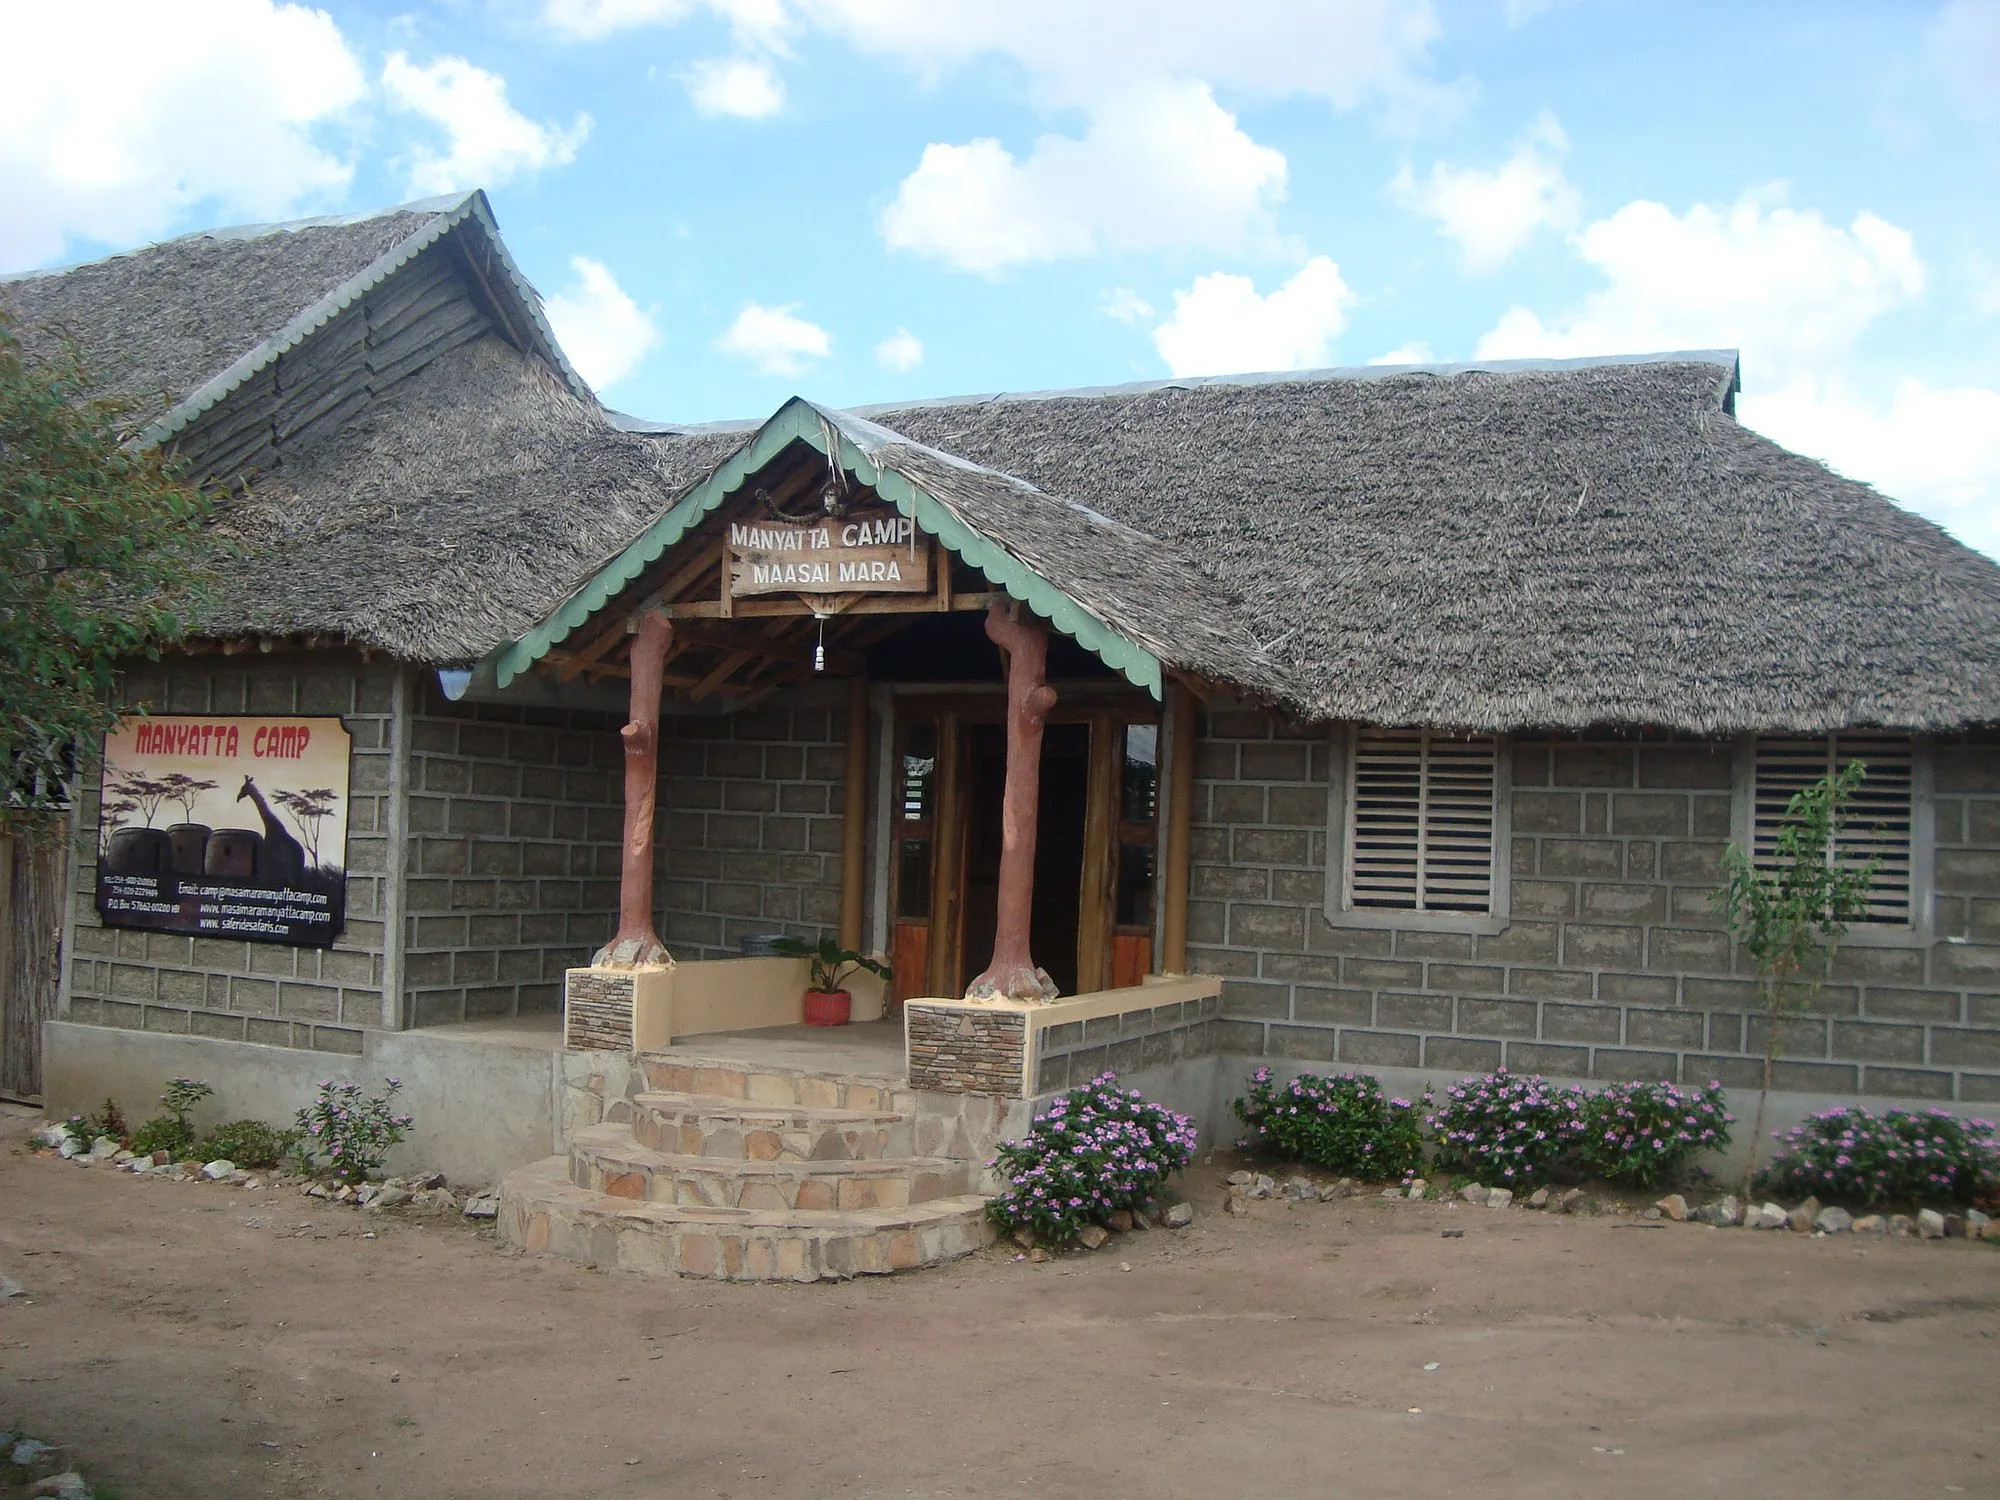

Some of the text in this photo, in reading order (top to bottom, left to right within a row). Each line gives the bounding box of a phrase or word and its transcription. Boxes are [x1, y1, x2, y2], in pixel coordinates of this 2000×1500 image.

[731, 518, 912, 550] MANYATTA CAMP
[753, 560, 902, 584] MAASAI MARA
[135, 724, 311, 759] MANYATTA CAMP
[178, 881, 199, 896] Email:
[221, 903, 331, 925] masaimaramanyattacamp.com
[222, 917, 289, 935] saferidesafaris.com
